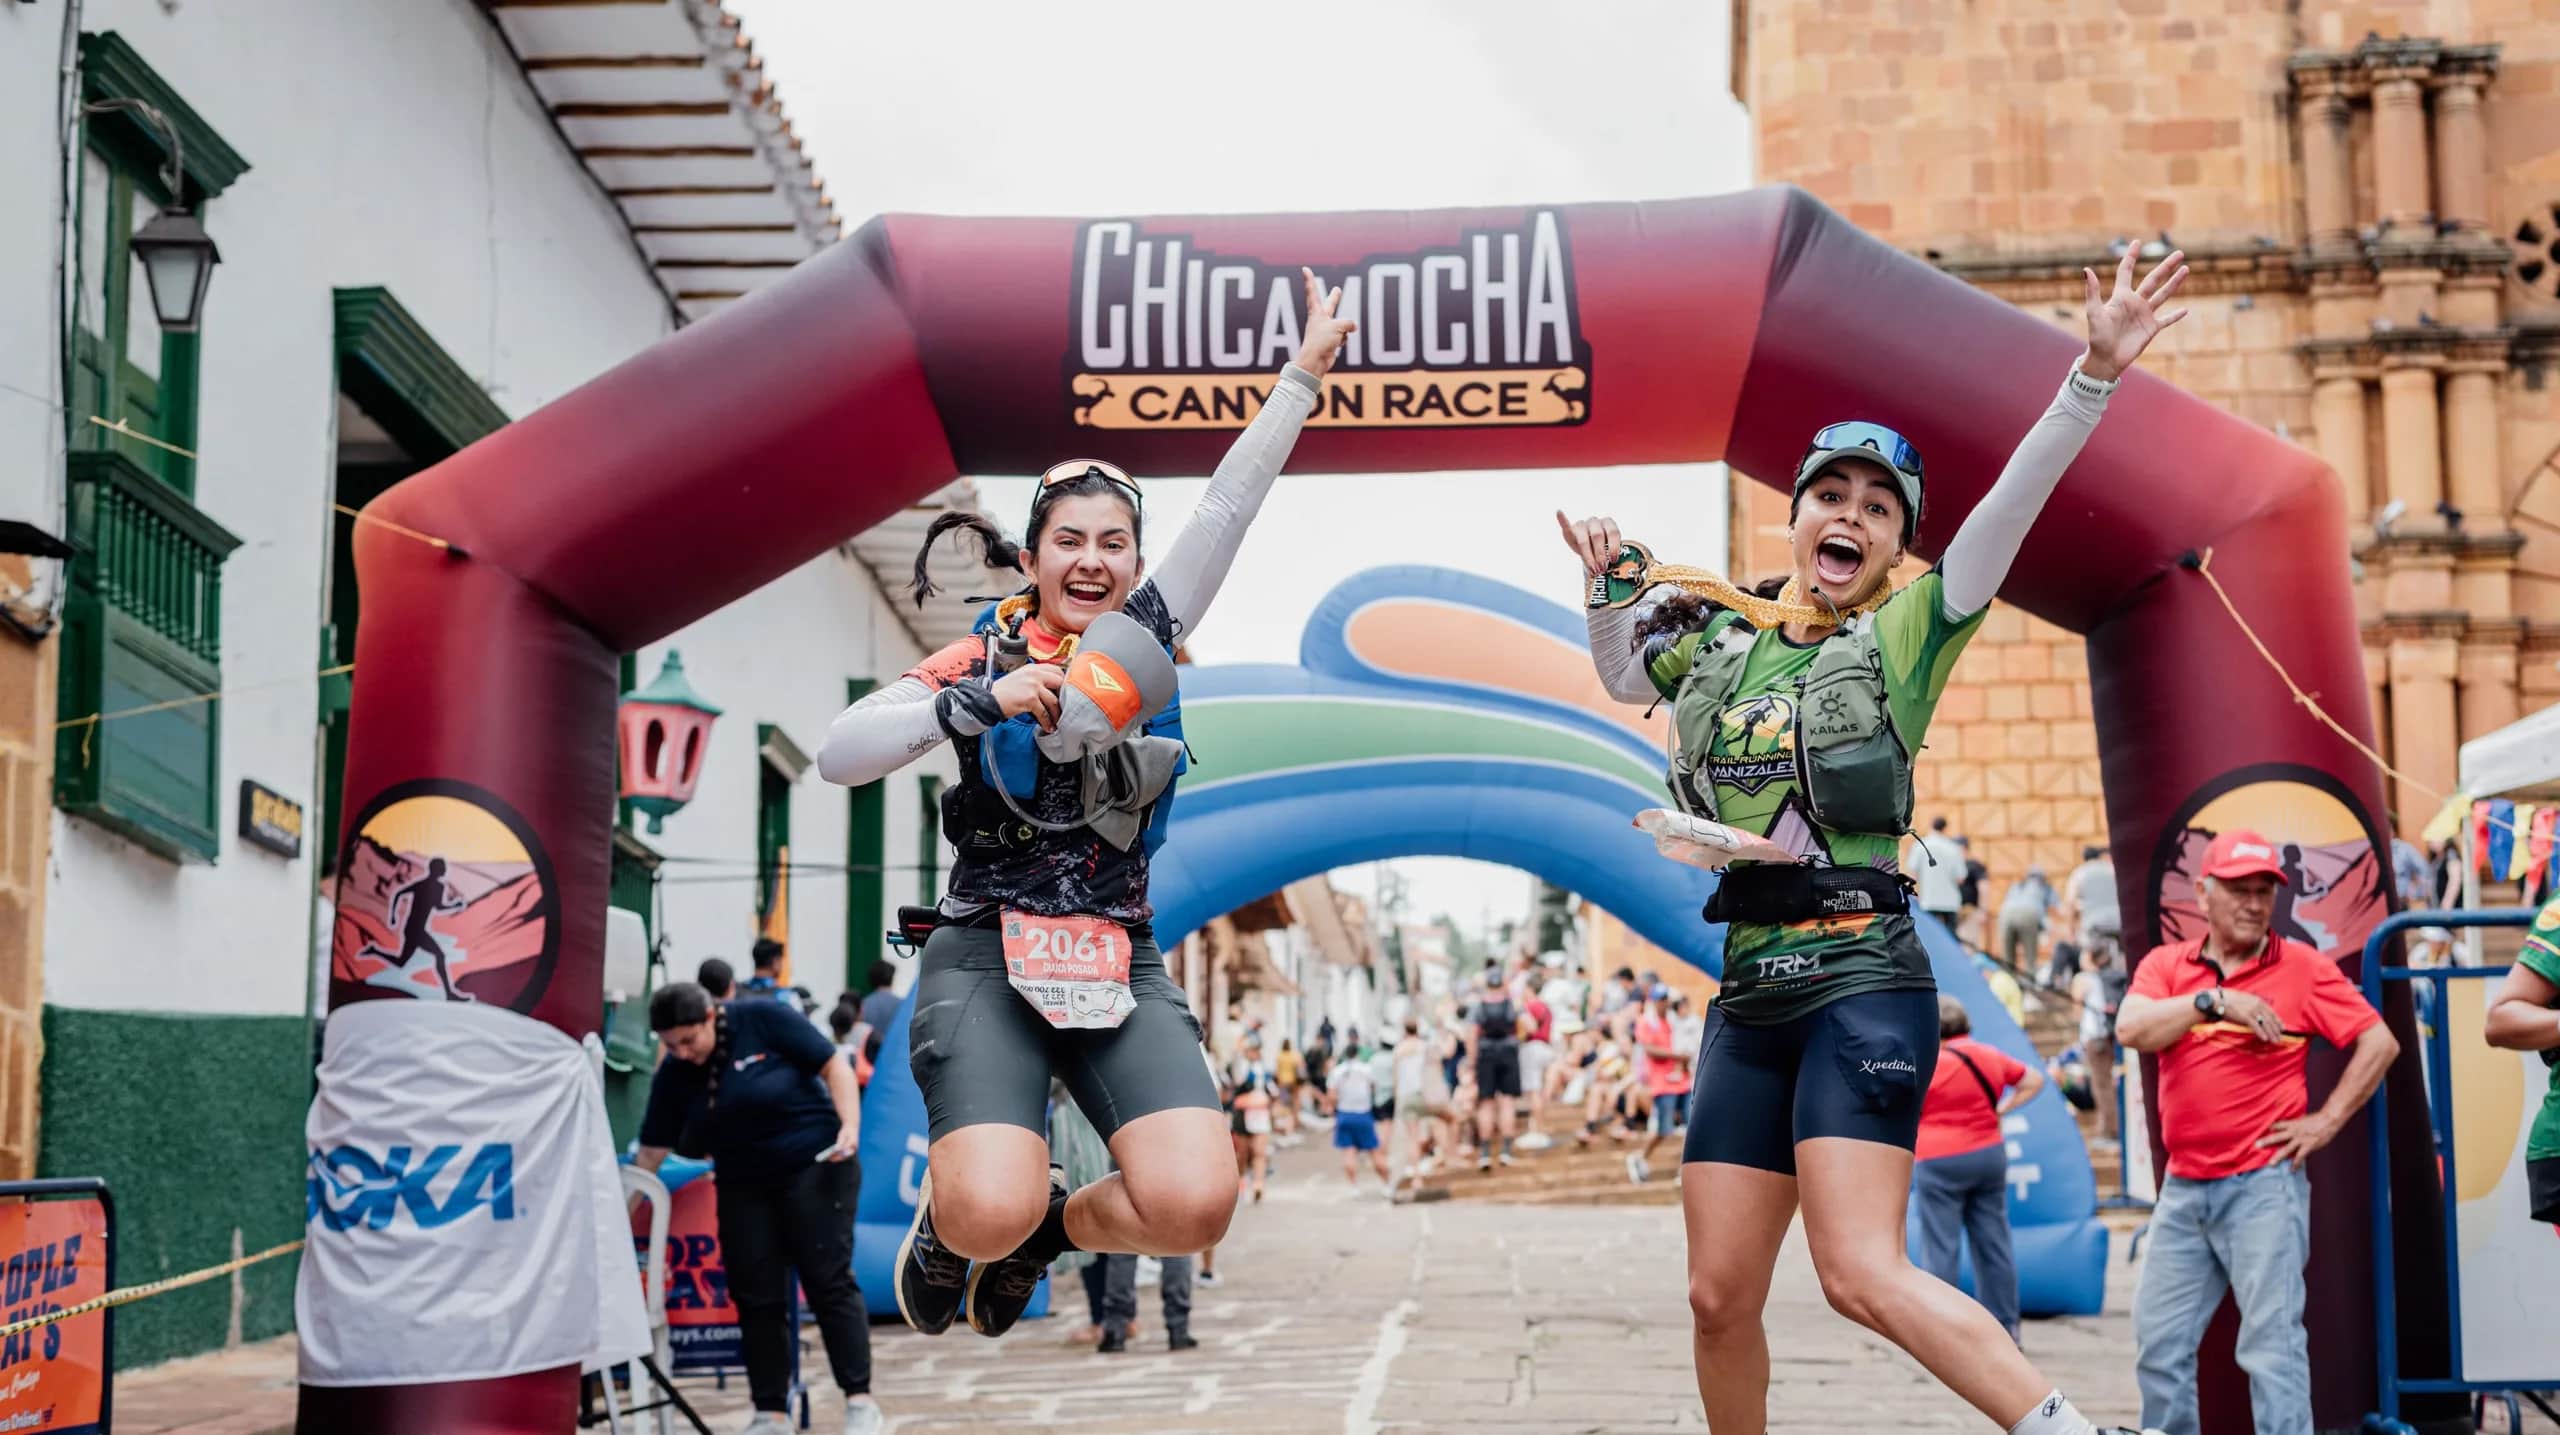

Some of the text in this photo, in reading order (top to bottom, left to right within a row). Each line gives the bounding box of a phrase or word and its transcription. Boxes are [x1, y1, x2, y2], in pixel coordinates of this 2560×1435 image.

[1383, 382, 1528, 419] RACE
[1809, 723, 1859, 737] KAILAS
[1837, 890, 1857, 900] THE
[1025, 927, 1117, 962] 2061
[1756, 951, 1821, 978] TRM
[307, 1142, 515, 1233] OKA
